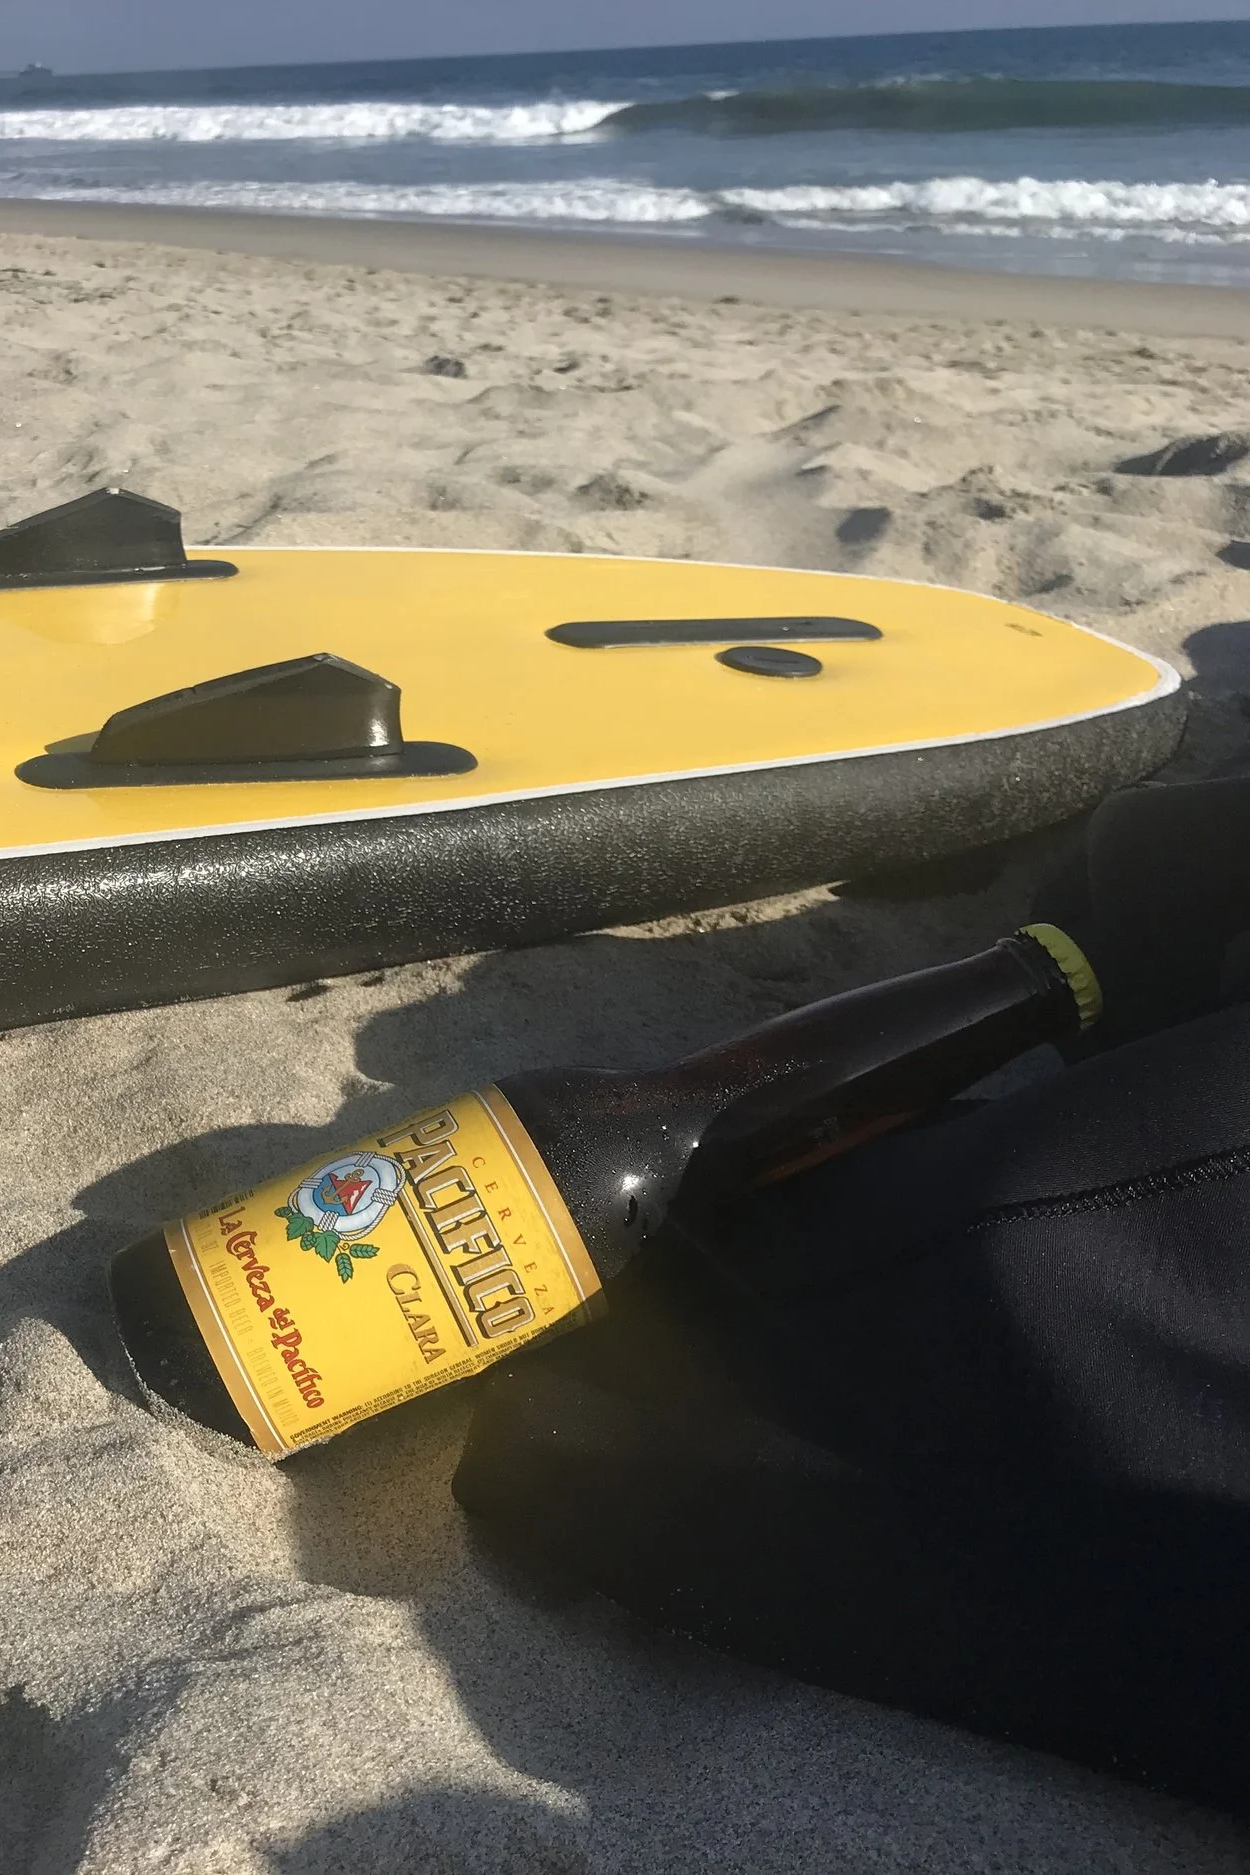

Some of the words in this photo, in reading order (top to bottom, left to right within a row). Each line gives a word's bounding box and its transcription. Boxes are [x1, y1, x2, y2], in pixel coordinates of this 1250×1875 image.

[218, 1206, 246, 1236] La
[377, 1108, 536, 1342] PACIFICO
[471, 1155, 555, 1316] CERVEZA
[225, 1231, 275, 1313] Cerveza
[268, 1307, 295, 1332] del
[386, 1262, 447, 1365] CLARA
[289, 1418, 331, 1440] GOVERNMENT
